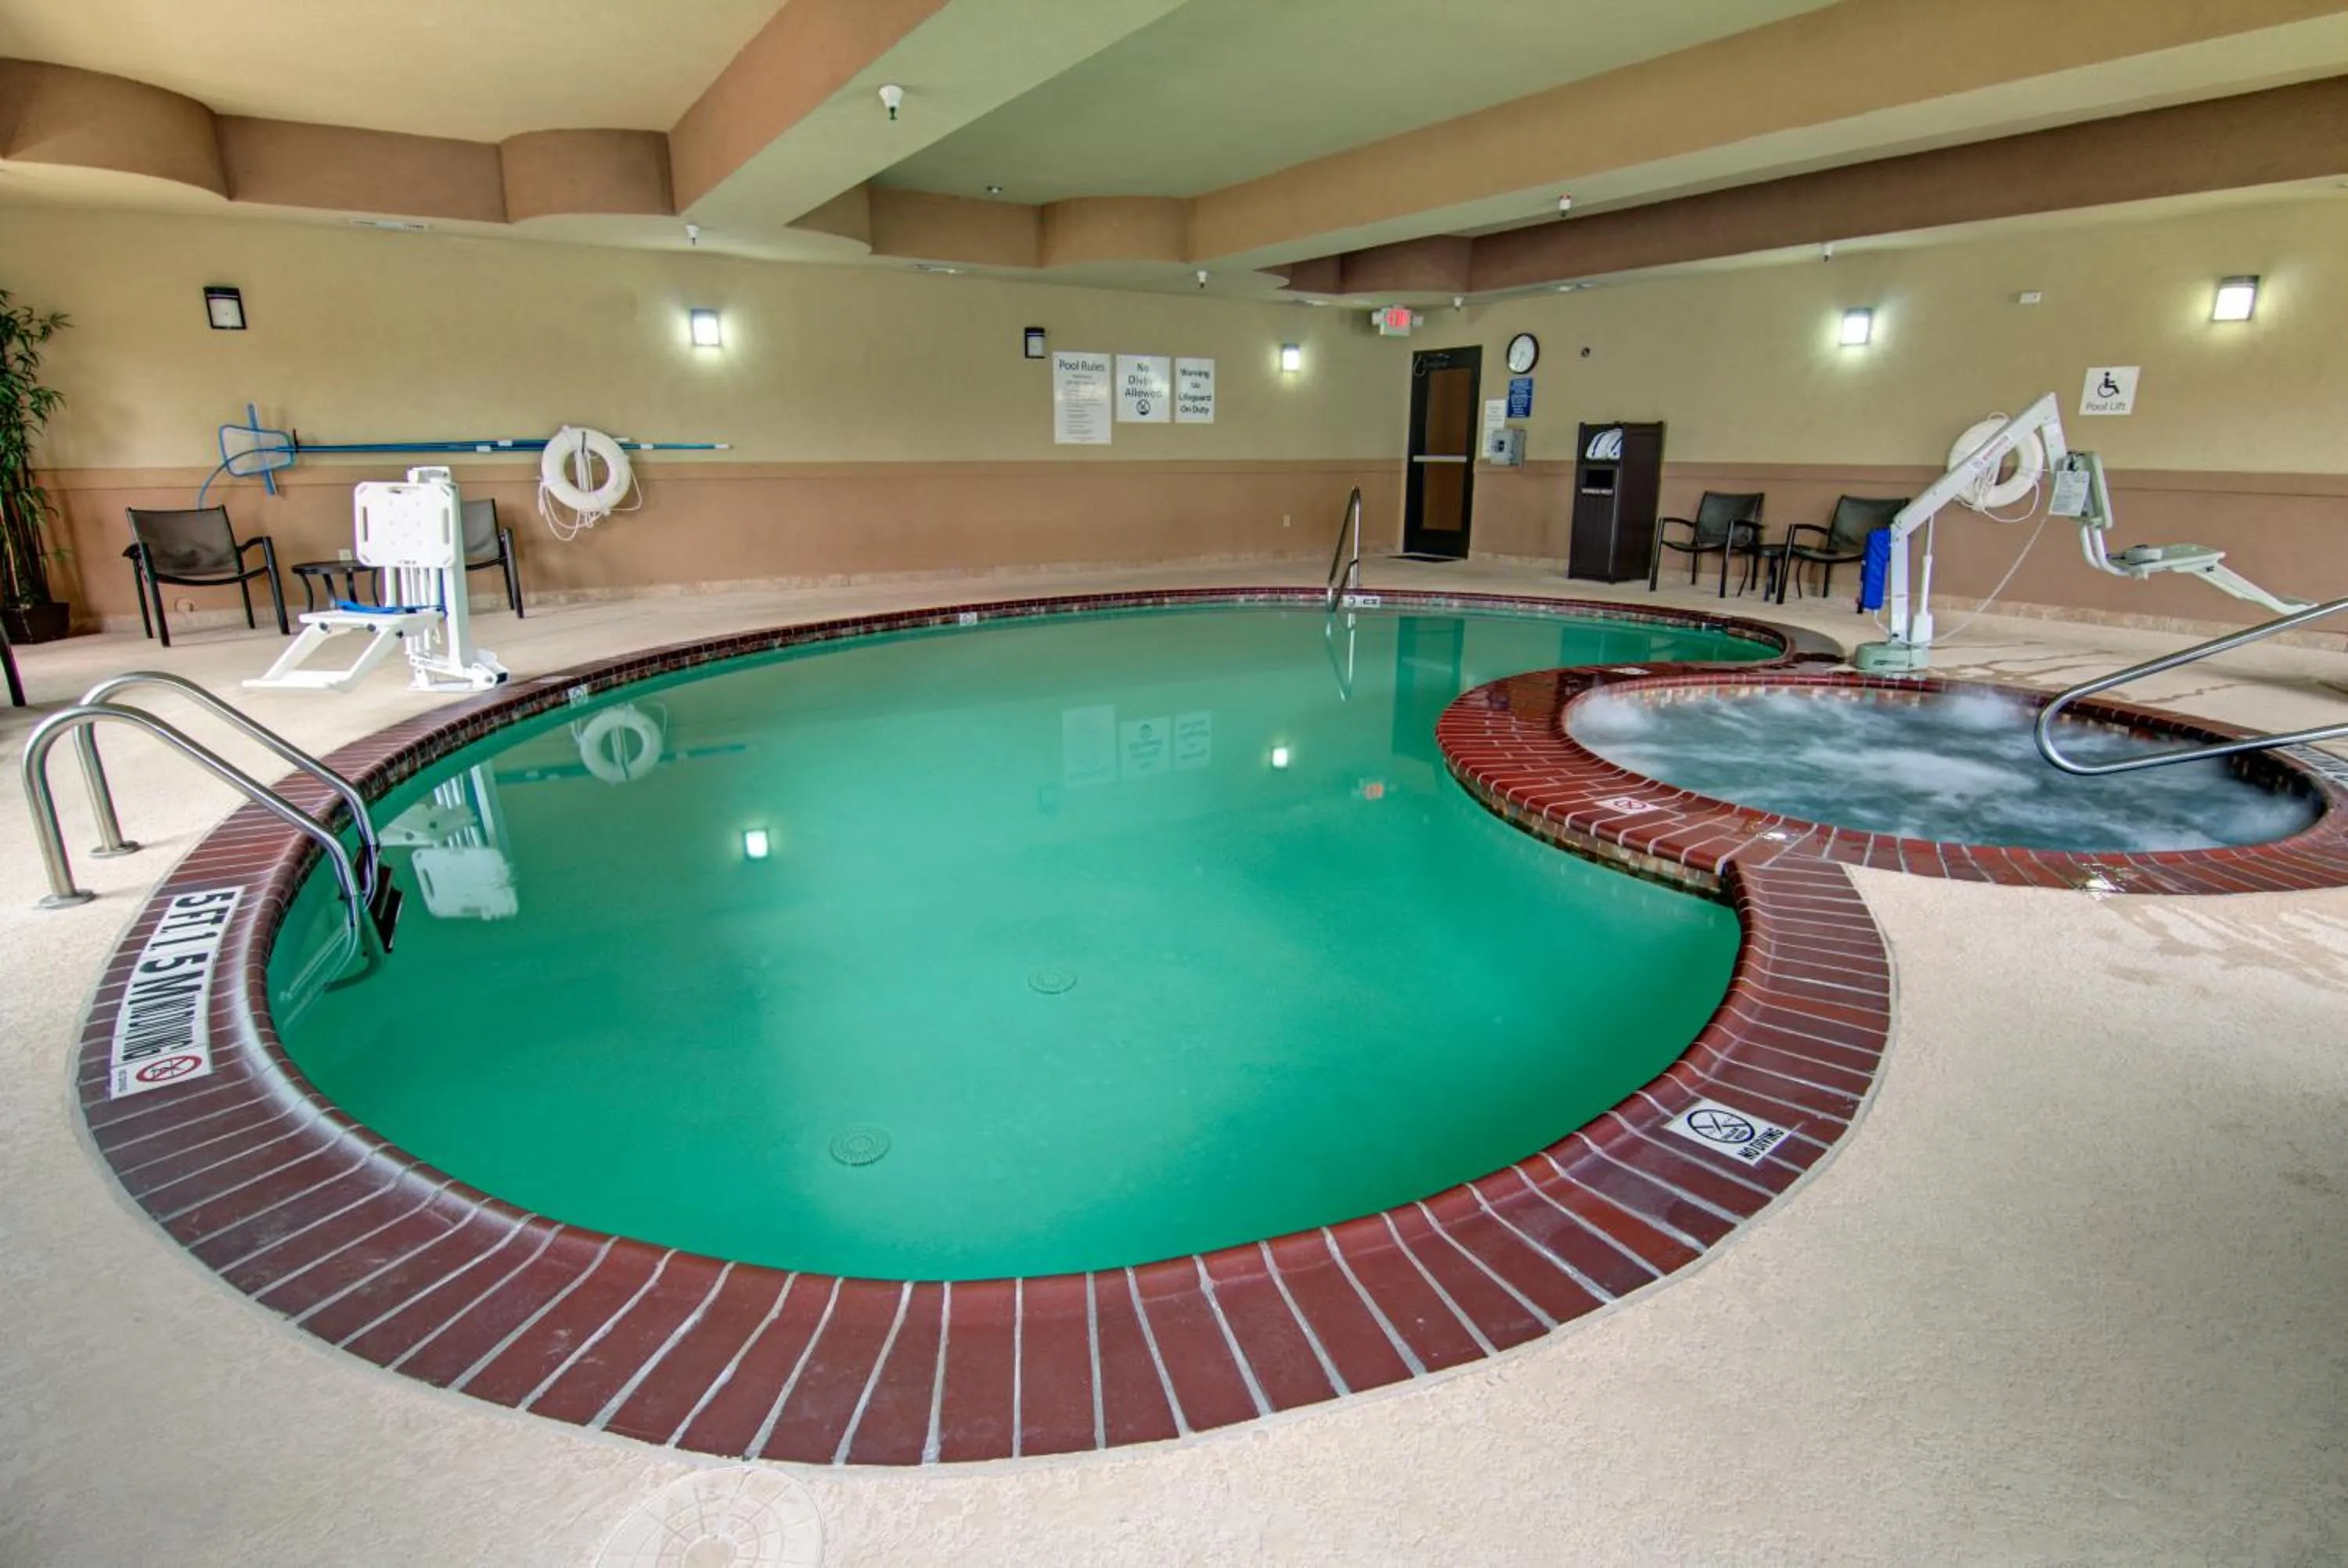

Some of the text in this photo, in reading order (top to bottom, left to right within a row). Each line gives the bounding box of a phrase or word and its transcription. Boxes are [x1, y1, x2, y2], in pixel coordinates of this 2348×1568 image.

[1059, 359, 1105, 372] Pool Rules
[1137, 362, 1151, 373] No
[1179, 369, 1210, 380] Warning
[1128, 375, 1155, 386] Divin
[1125, 387, 1163, 398] Allowed
[1178, 392, 1212, 403] Lifeguard
[1179, 405, 1210, 416] On Duty
[2085, 401, 2126, 412] Pool Lift
[175, 891, 236, 908] 5
